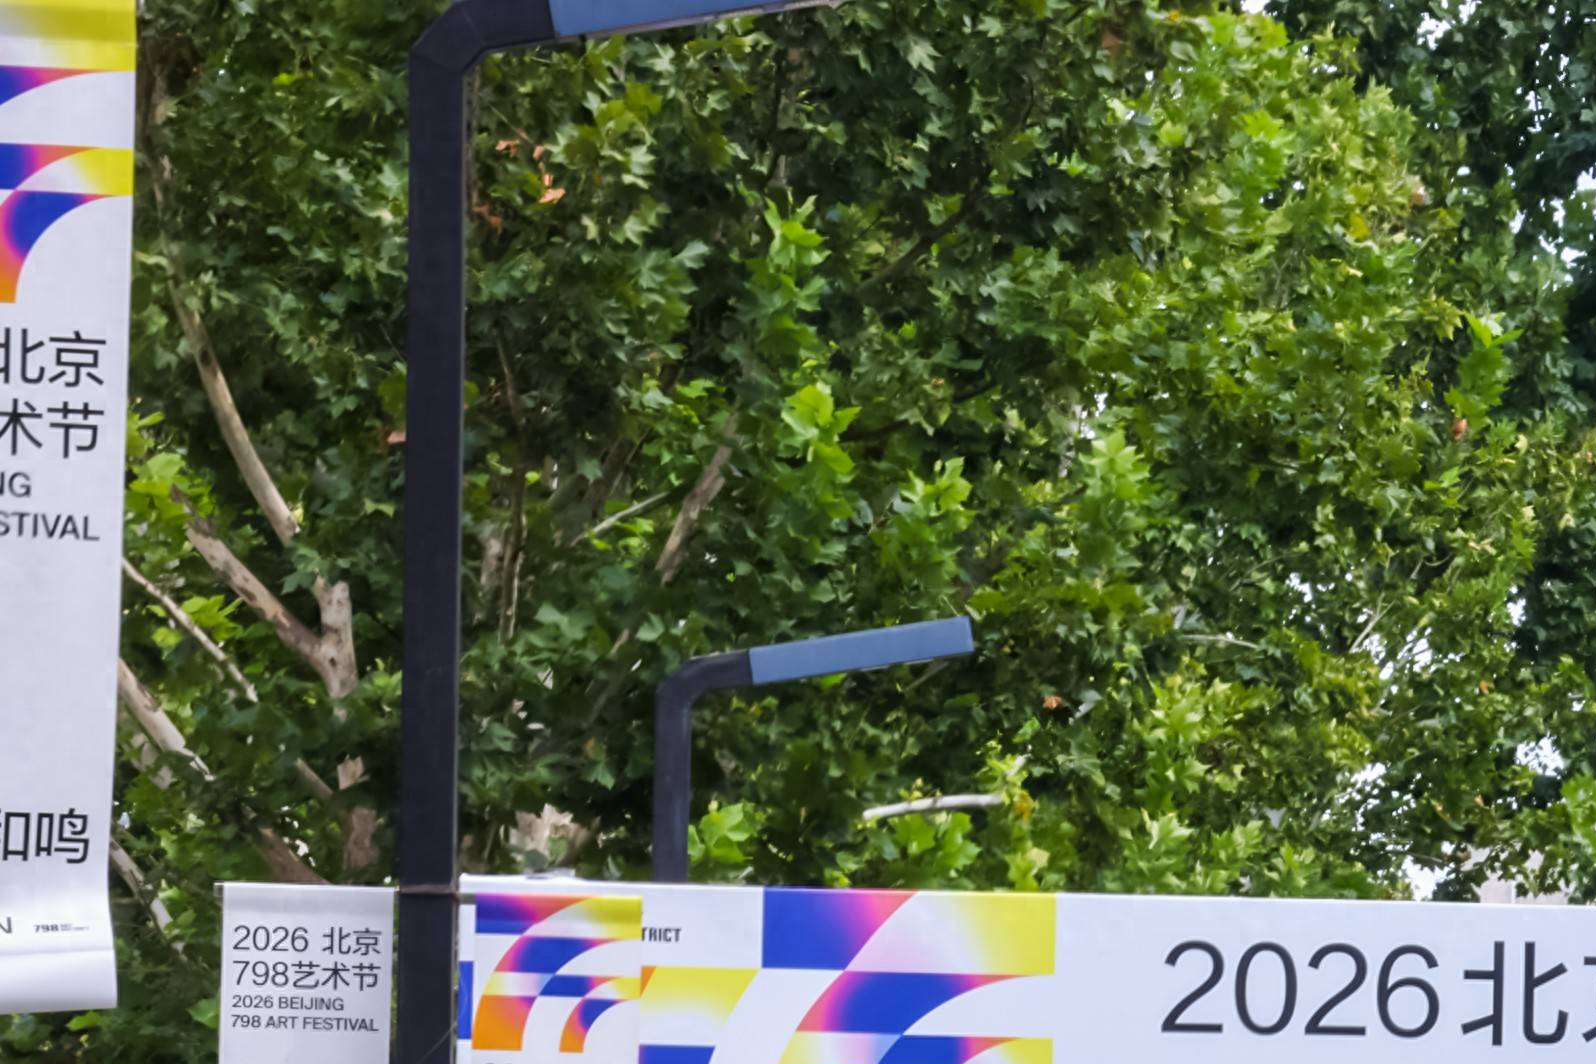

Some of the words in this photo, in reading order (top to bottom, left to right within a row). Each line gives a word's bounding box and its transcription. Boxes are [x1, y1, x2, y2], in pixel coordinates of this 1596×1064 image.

[0, 326, 107, 388] 北京
[0, 398, 104, 459] 术节
[233, 925, 309, 952] 2026
[321, 927, 382, 956] 北京
[233, 960, 382, 991] 798艺术节
[232, 994, 273, 1009] 2026
[278, 996, 344, 1011] BEIJING
[231, 1014, 261, 1028] 798
[265, 1015, 299, 1030] ART
[303, 1017, 379, 1032] FESTIVAL
